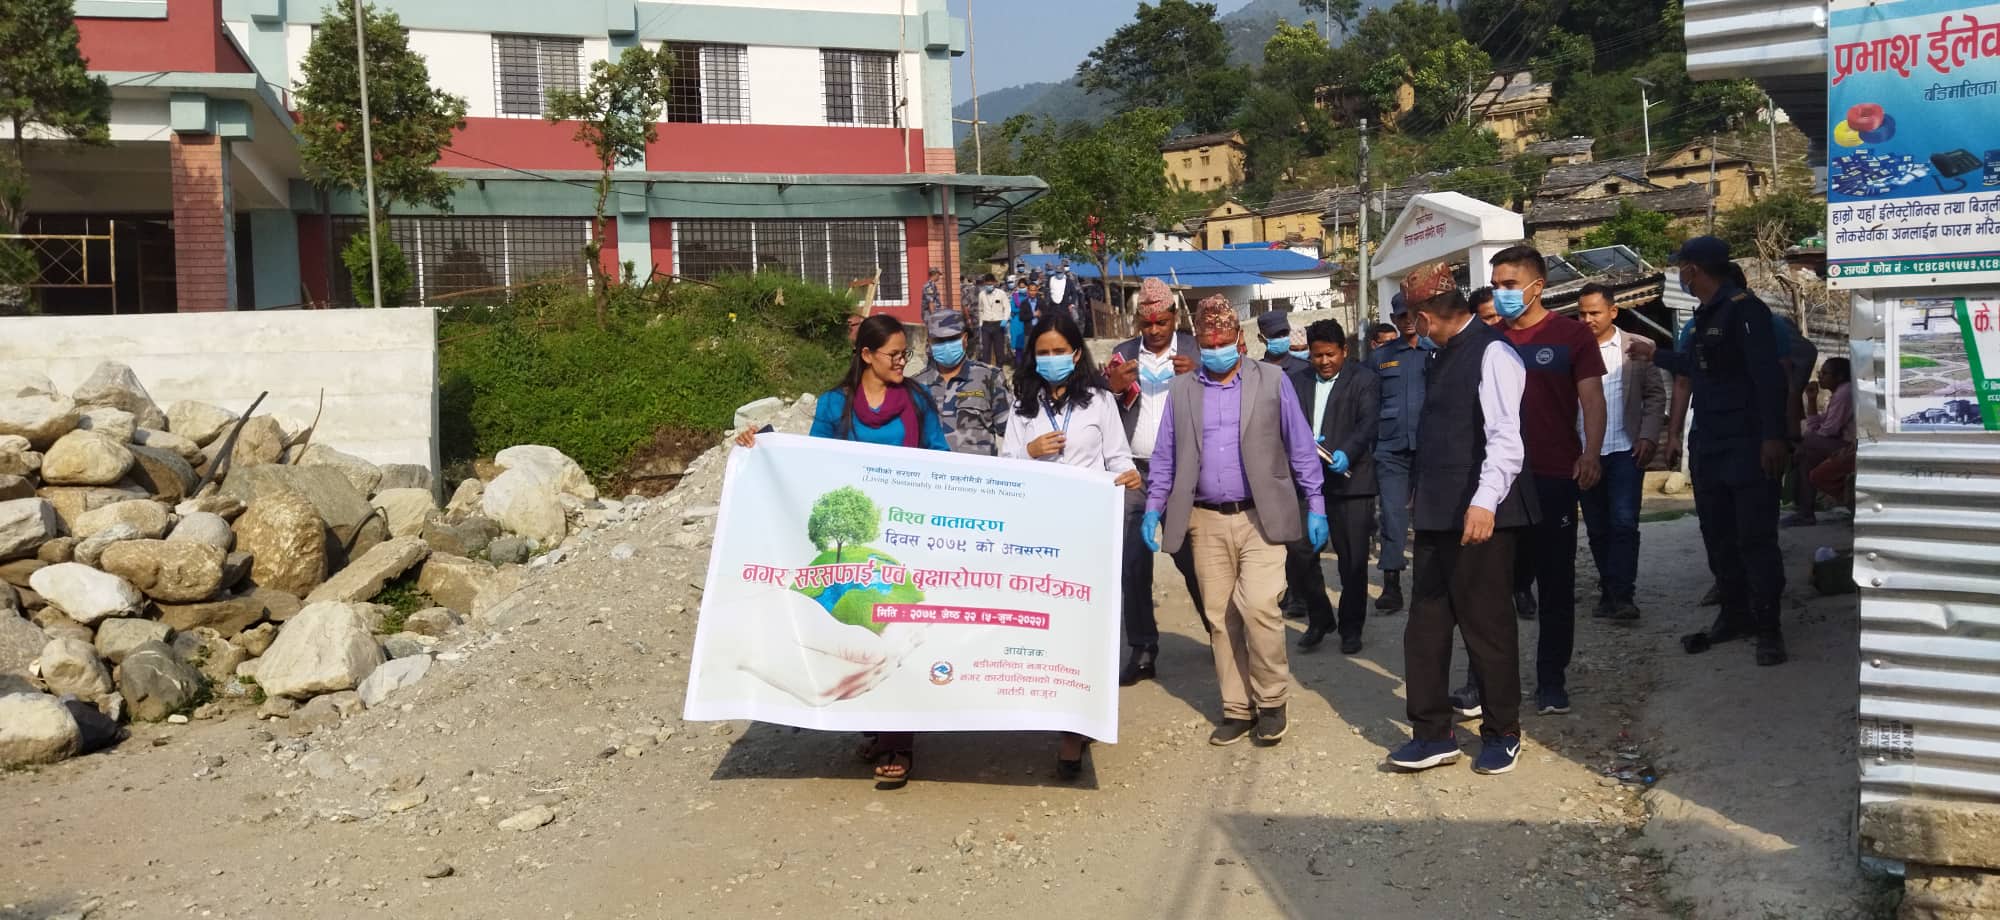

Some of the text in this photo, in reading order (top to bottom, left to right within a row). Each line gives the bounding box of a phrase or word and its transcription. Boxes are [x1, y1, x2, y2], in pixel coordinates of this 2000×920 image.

[1832, 34, 1921, 85] प्रभाश
[1832, 206, 1853, 225] हाम्रो
[1857, 204, 1875, 223] यहाँ
[1879, 201, 1940, 222] ईलेक्ट्रोनिक्स
[1944, 202, 1966, 215] तथा
[1891, 222, 1938, 241] अनलाईन
[1941, 224, 1972, 237] फारम
[1843, 262, 1869, 276] सम्पर्क
[1873, 261, 1892, 273] फोन
[892, 477, 932, 490] Sustainably
[934, 482, 942, 490] in
[944, 483, 978, 495] Harmony
[980, 486, 996, 496] with
[887, 506, 1006, 533] विश्व वातावरण
[885, 528, 1062, 559] दिवस २०७९ को अवसरमा
[741, 559, 1092, 603] नगर सरसफाई एवं बृक्षारोपण कार्यक्रम
[876, 605, 899, 618] मिति
[909, 608, 937, 621] २०७९
[964, 611, 977, 622] २२
[1026, 663, 1081, 677] नगरपालिका
[959, 674, 981, 682] नगर
[1052, 677, 1092, 692] कार्यालय
